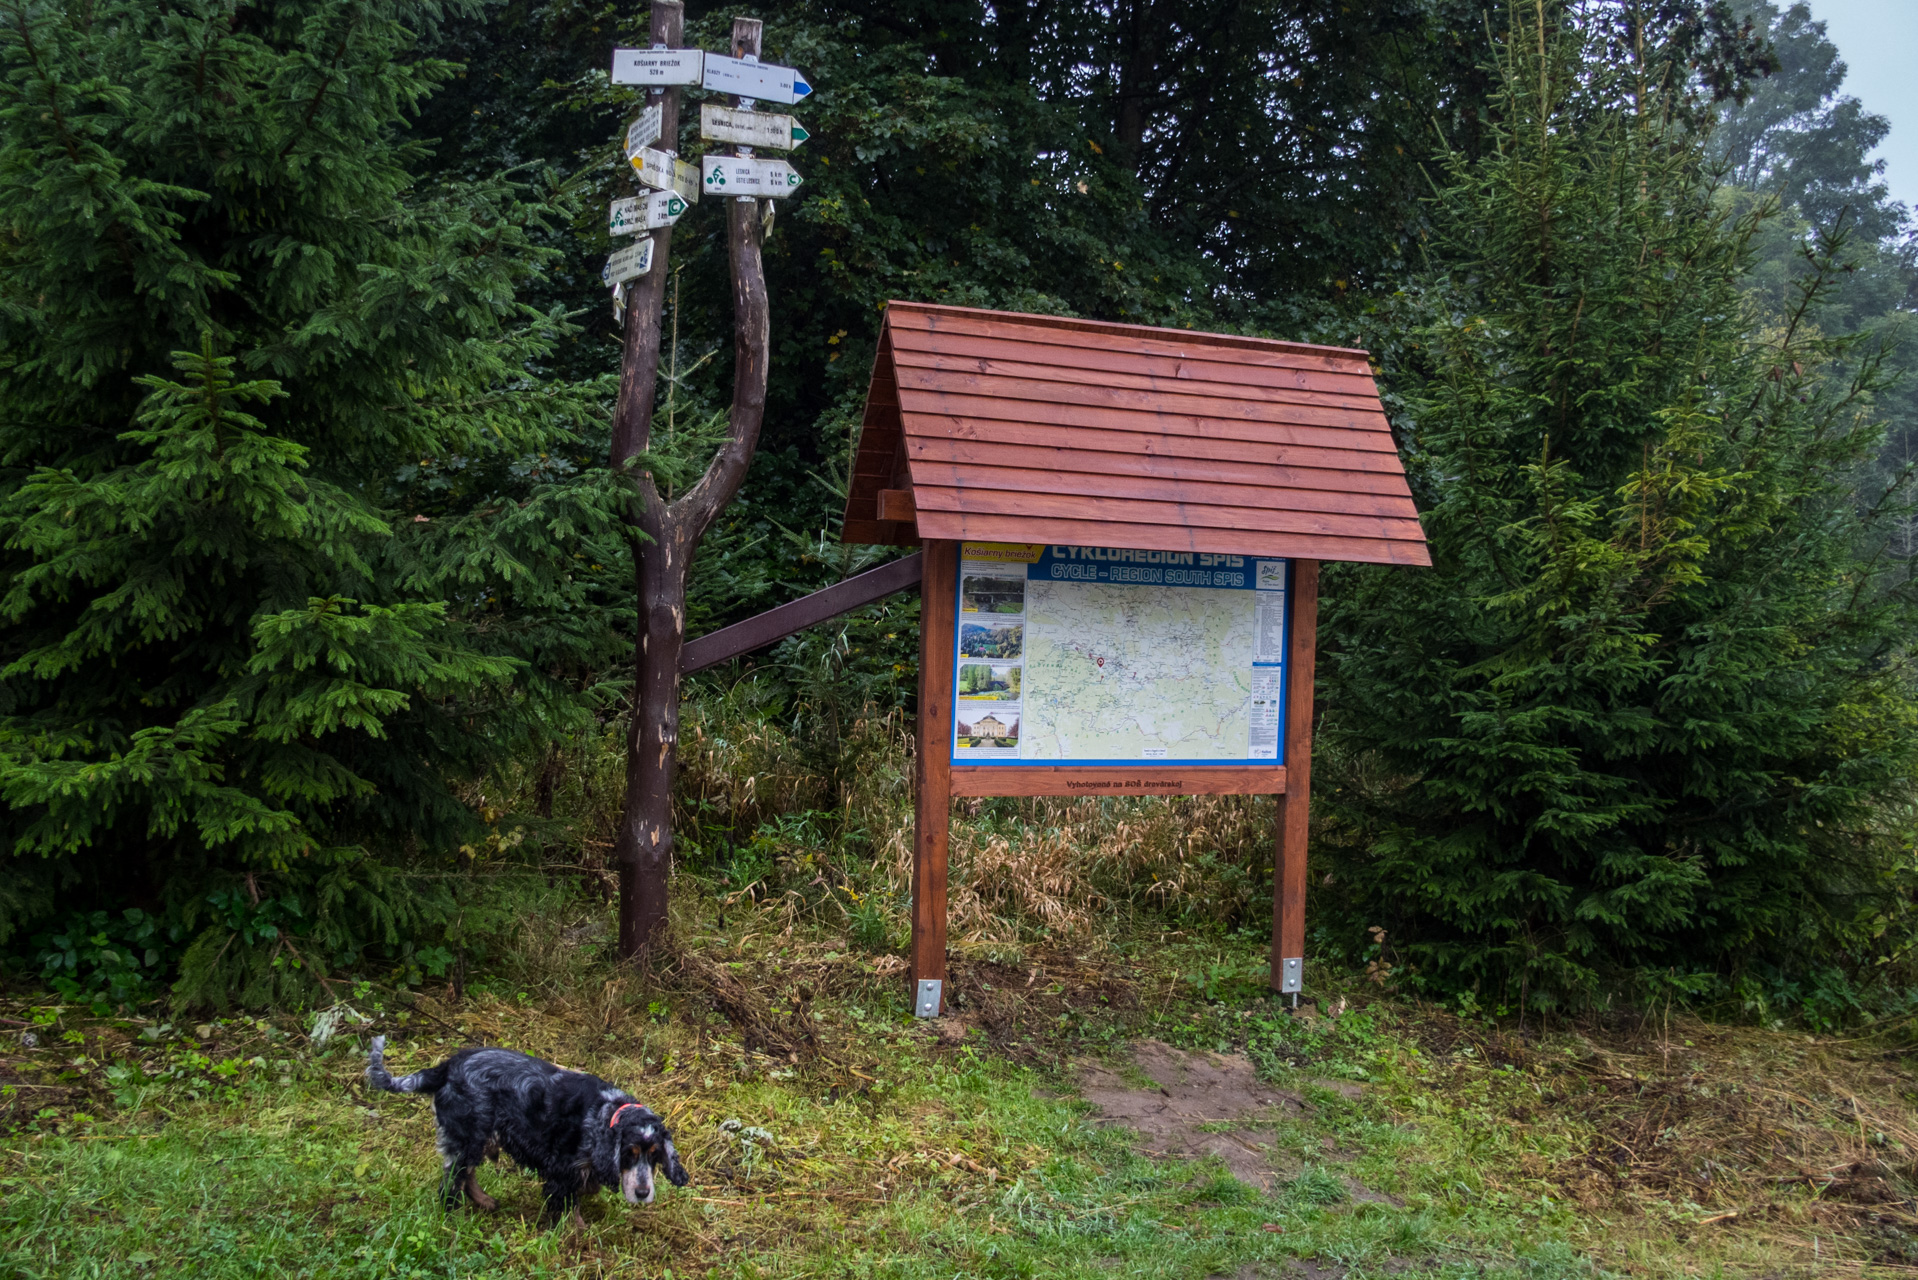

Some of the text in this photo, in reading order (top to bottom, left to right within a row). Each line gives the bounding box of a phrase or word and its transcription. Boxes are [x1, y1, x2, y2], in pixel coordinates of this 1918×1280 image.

[633, 59, 658, 67] KOŠIARNY
[964, 547, 1036, 559] Košiarny briežok
[1051, 545, 1194, 565] CYKLOREGION
[1050, 563, 1098, 580] CYCLE
[1109, 566, 1163, 583] REGION
[1164, 568, 1212, 586] SOUTH
[1213, 571, 1245, 587] SPIS
